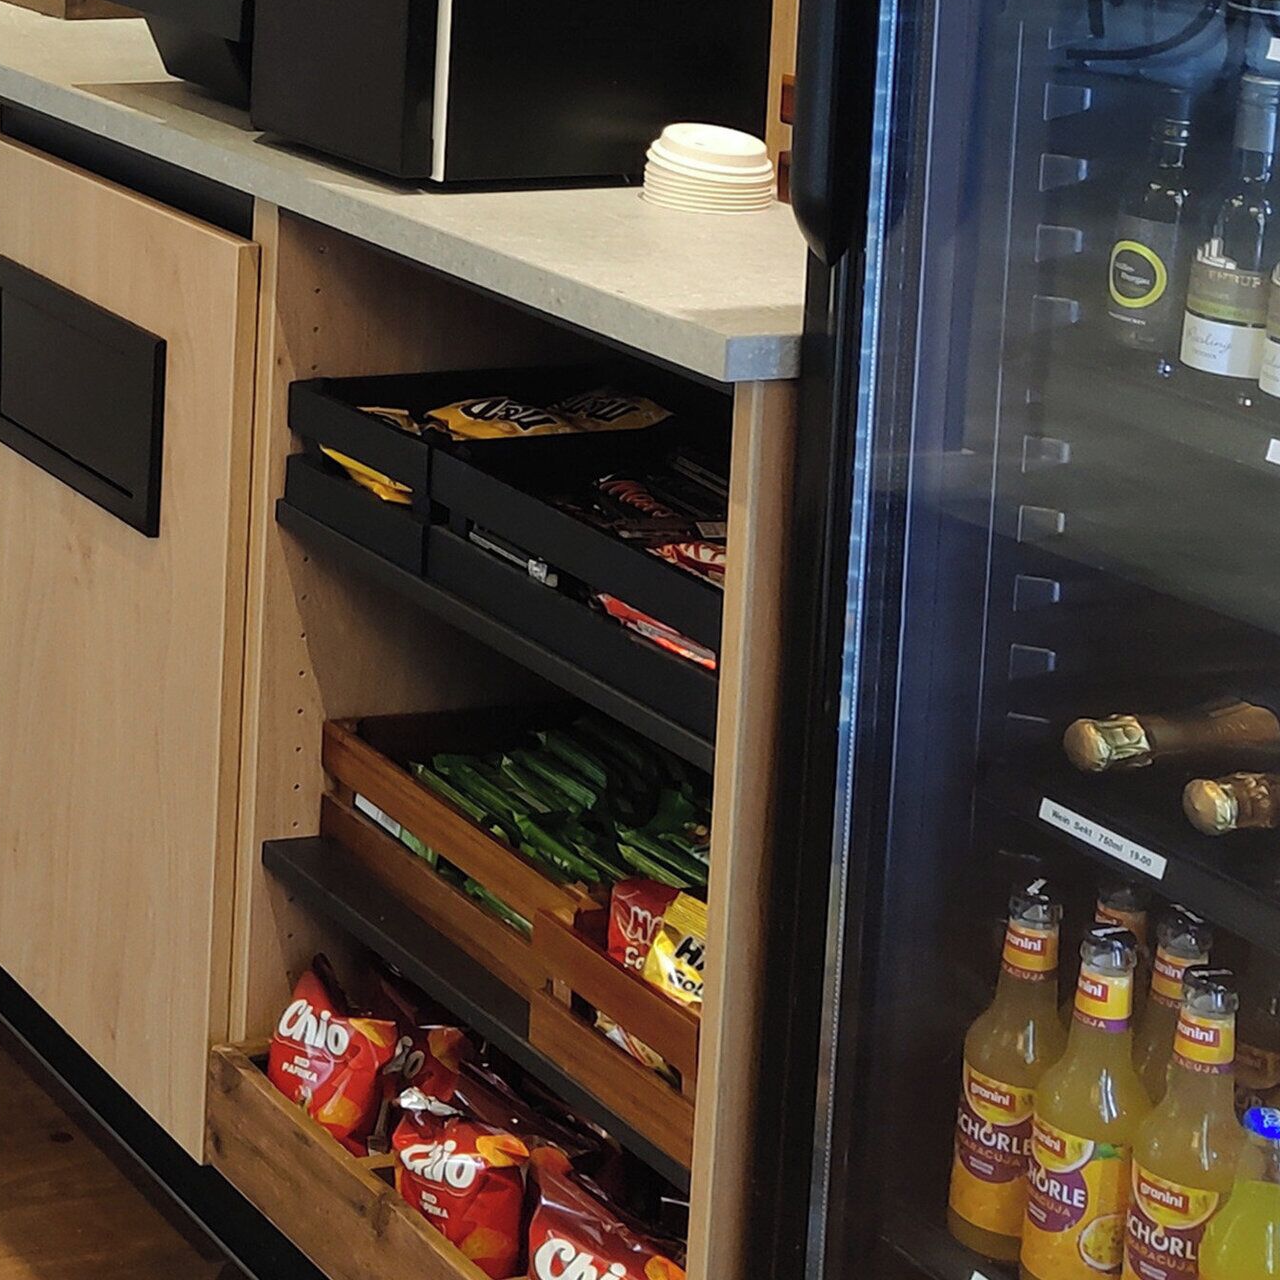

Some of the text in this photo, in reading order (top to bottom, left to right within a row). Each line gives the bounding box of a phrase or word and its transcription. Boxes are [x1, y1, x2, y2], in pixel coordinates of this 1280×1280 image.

[1073, 821, 1093, 837] Sekt
[277, 998, 351, 1057] Chio
[1140, 1181, 1184, 1209] granini
